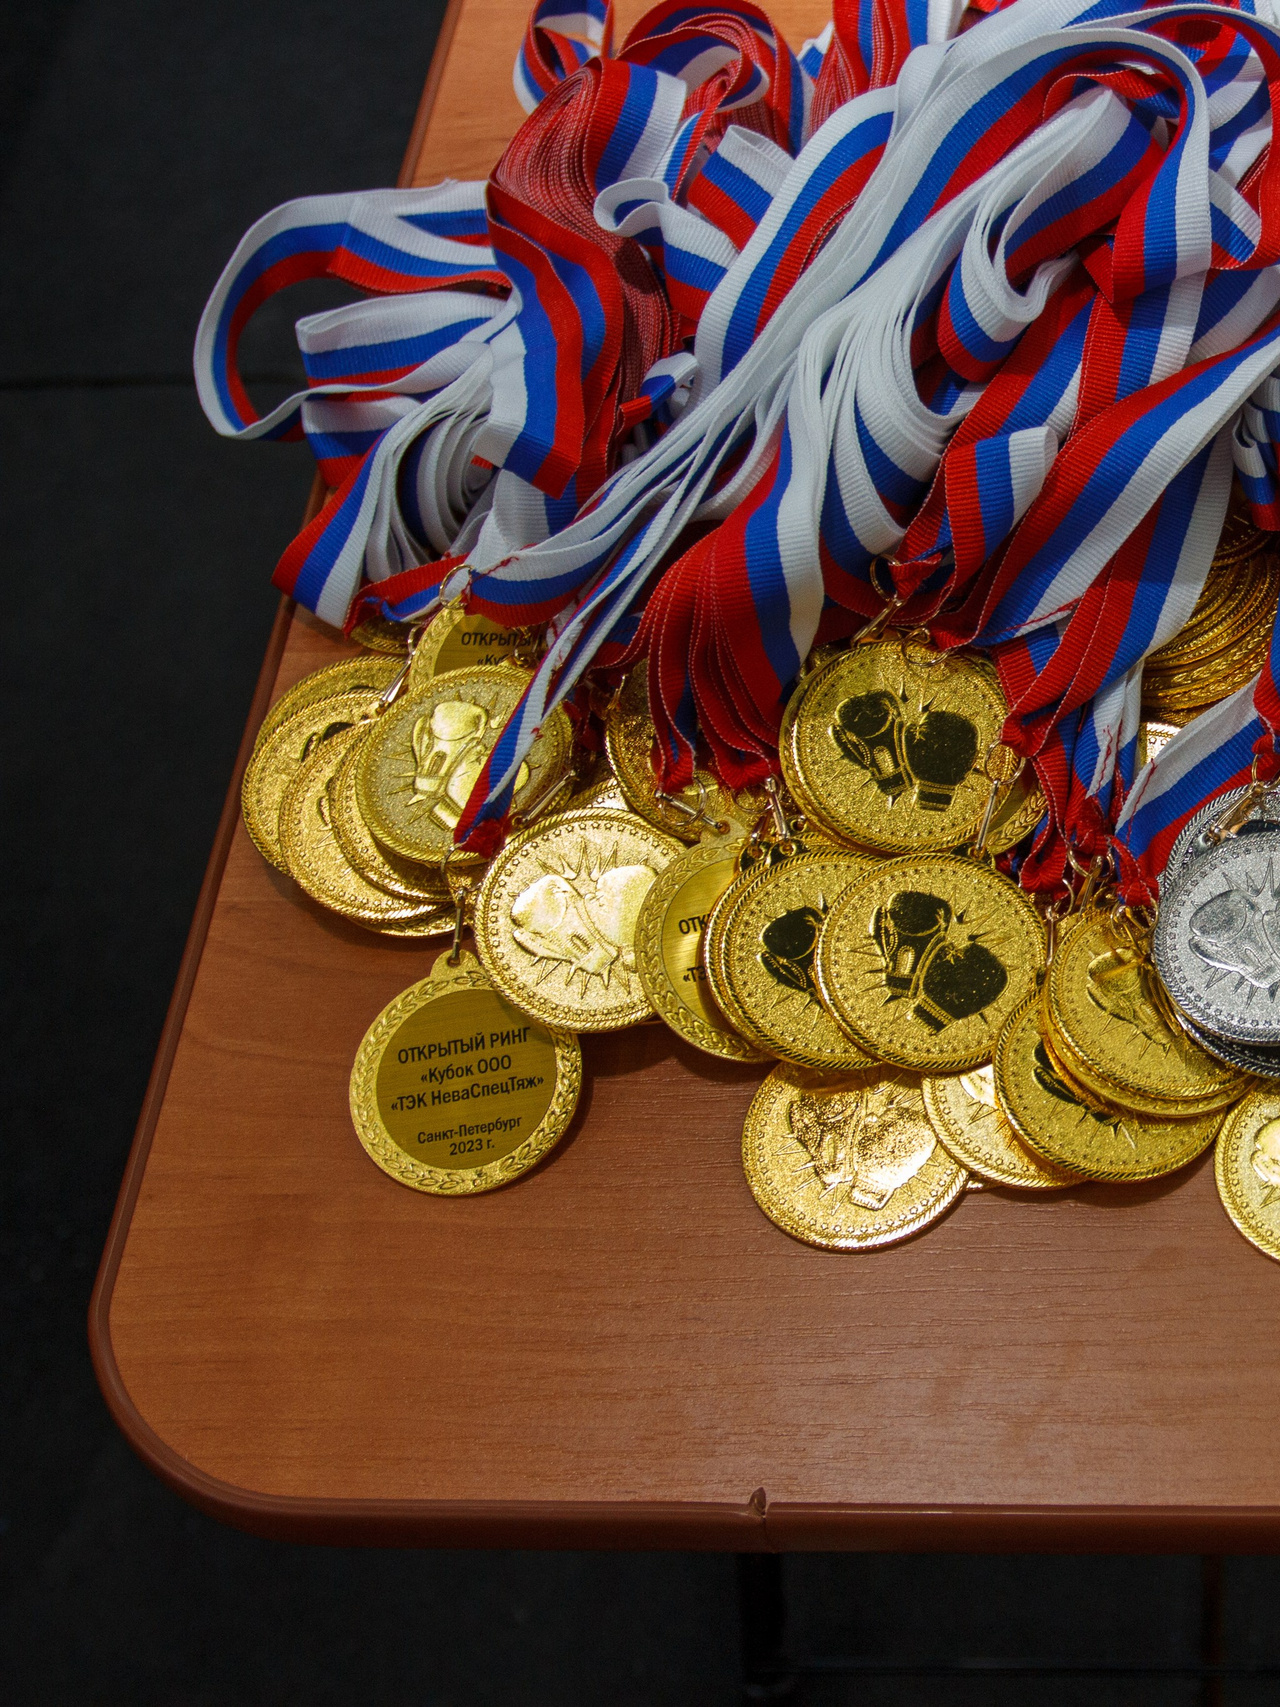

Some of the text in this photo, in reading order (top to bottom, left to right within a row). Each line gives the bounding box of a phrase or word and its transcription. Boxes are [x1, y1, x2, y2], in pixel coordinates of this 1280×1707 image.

[461, 631, 541, 646] ОТКРЫТЫ
[397, 1026, 531, 1064] ОТКРЫТЫЙ РИНГ
[420, 1054, 512, 1085] «Кубок ООО
[391, 1076, 545, 1111] «ТЭК НеваСпецТяж»
[417, 1116, 523, 1144] Санкт-Петербург
[449, 1138, 496, 1156] 2023 г.
